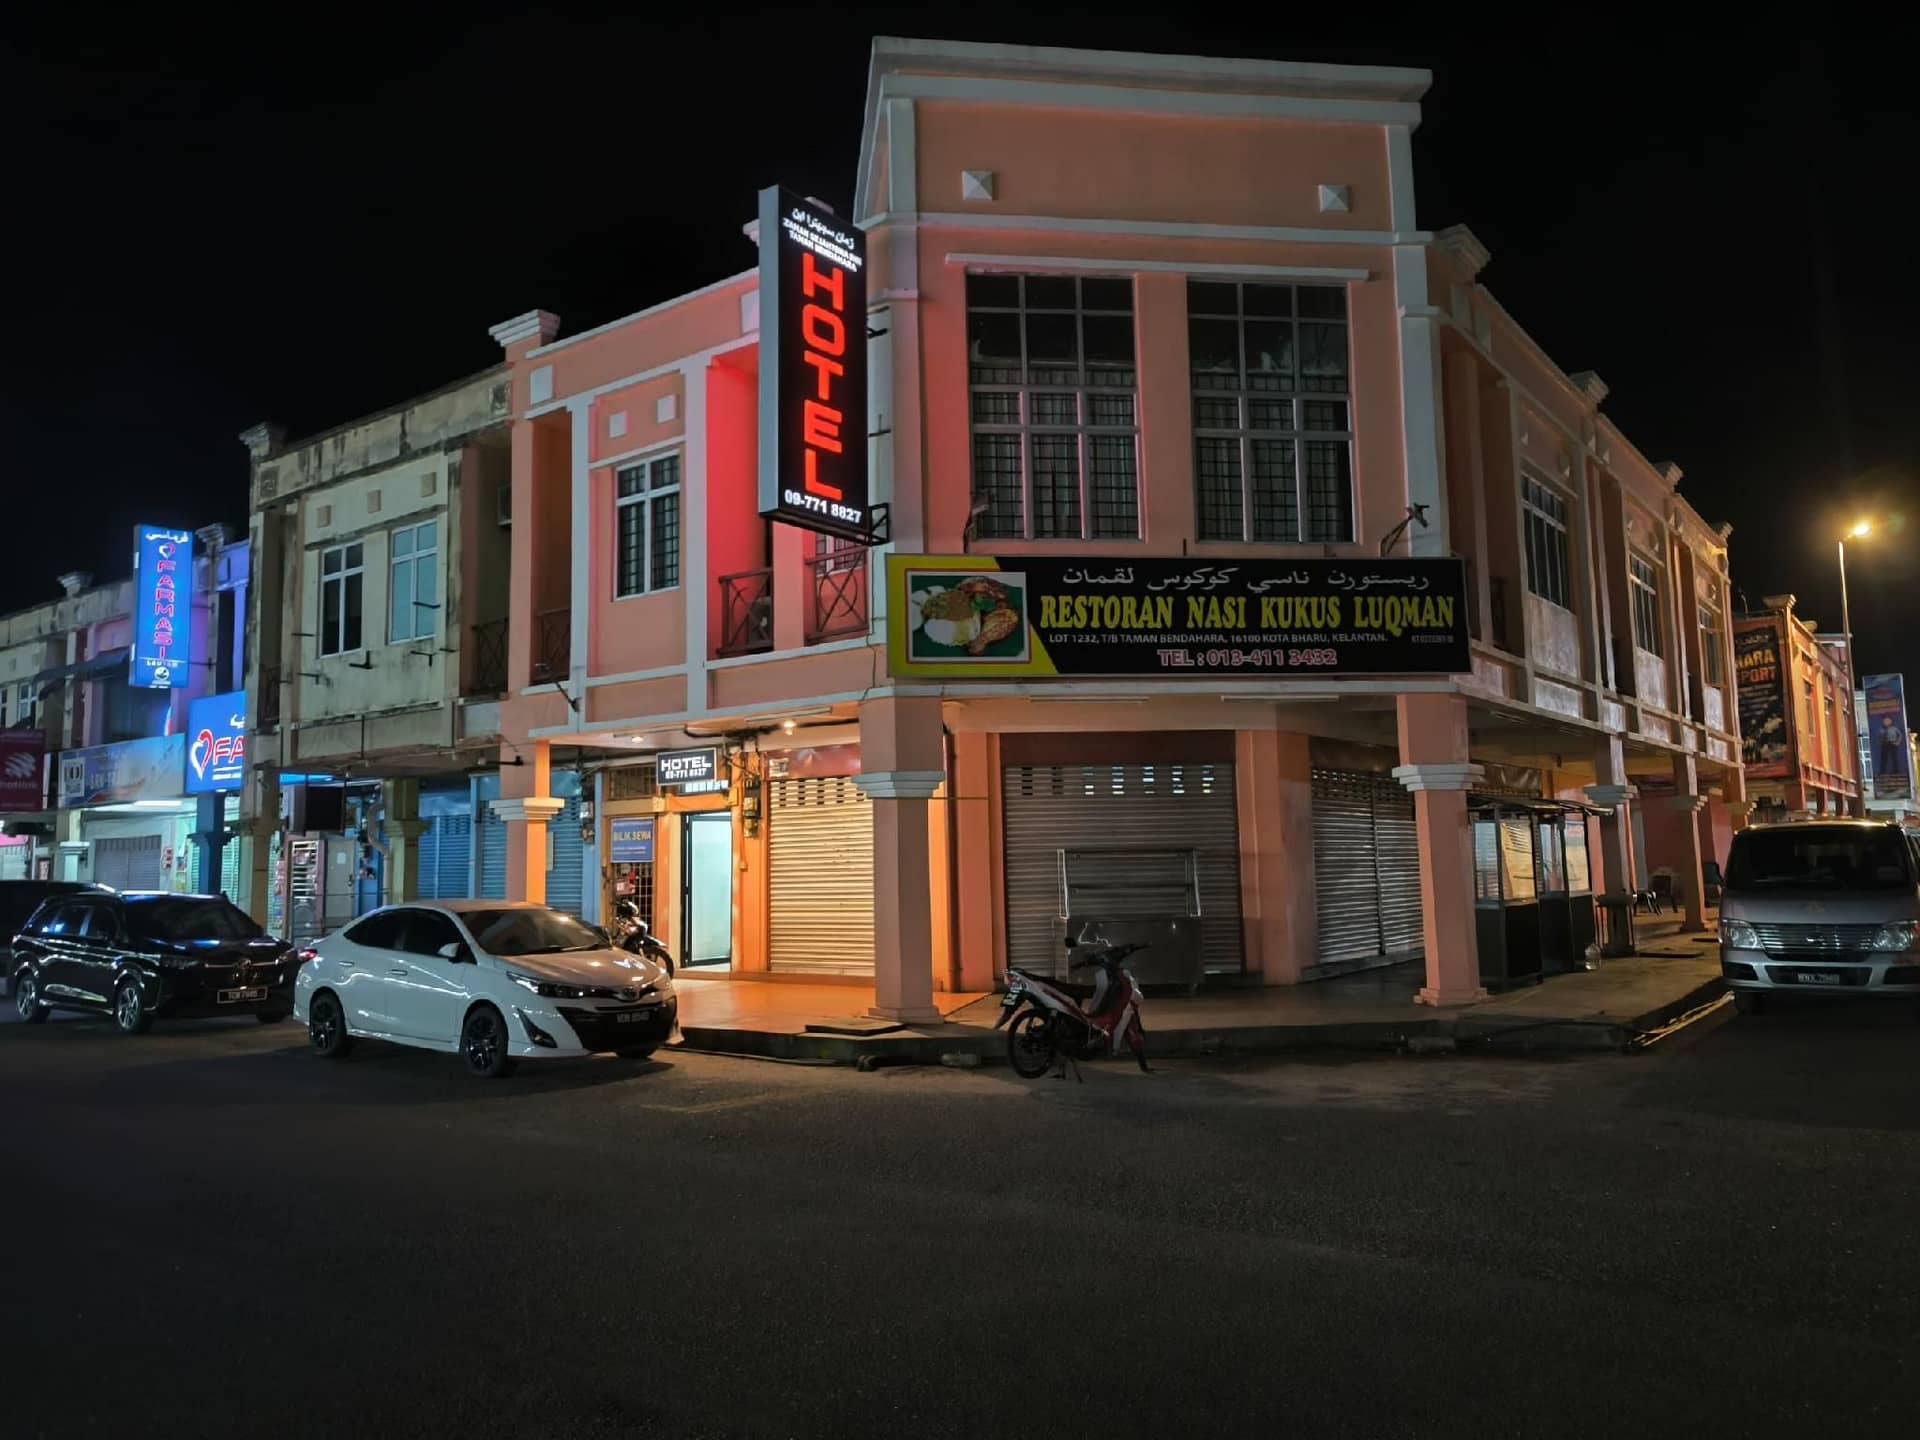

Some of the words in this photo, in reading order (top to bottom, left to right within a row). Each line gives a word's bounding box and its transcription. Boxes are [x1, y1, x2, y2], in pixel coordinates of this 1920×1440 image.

[802, 252, 845, 501] HOTEL
[784, 488, 828, 514] 09-771
[830, 503, 862, 524] 8827
[1062, 567, 1135, 584] لقمان
[1246, 570, 1311, 594] ناسي
[153, 559, 176, 661] FARMASI
[1039, 595, 1176, 629] RESTORAN
[1186, 596, 1248, 629] NASI
[1260, 596, 1341, 629] KUKUS
[1353, 596, 1455, 637] LUQMAN
[1049, 634, 1069, 643] LOT
[1101, 634, 1119, 644] T/B
[1120, 634, 1158, 643] TAMAN
[1262, 633, 1290, 643] KOTA
[1288, 648, 1338, 666] 3432
[661, 756, 712, 772] HOTEL
